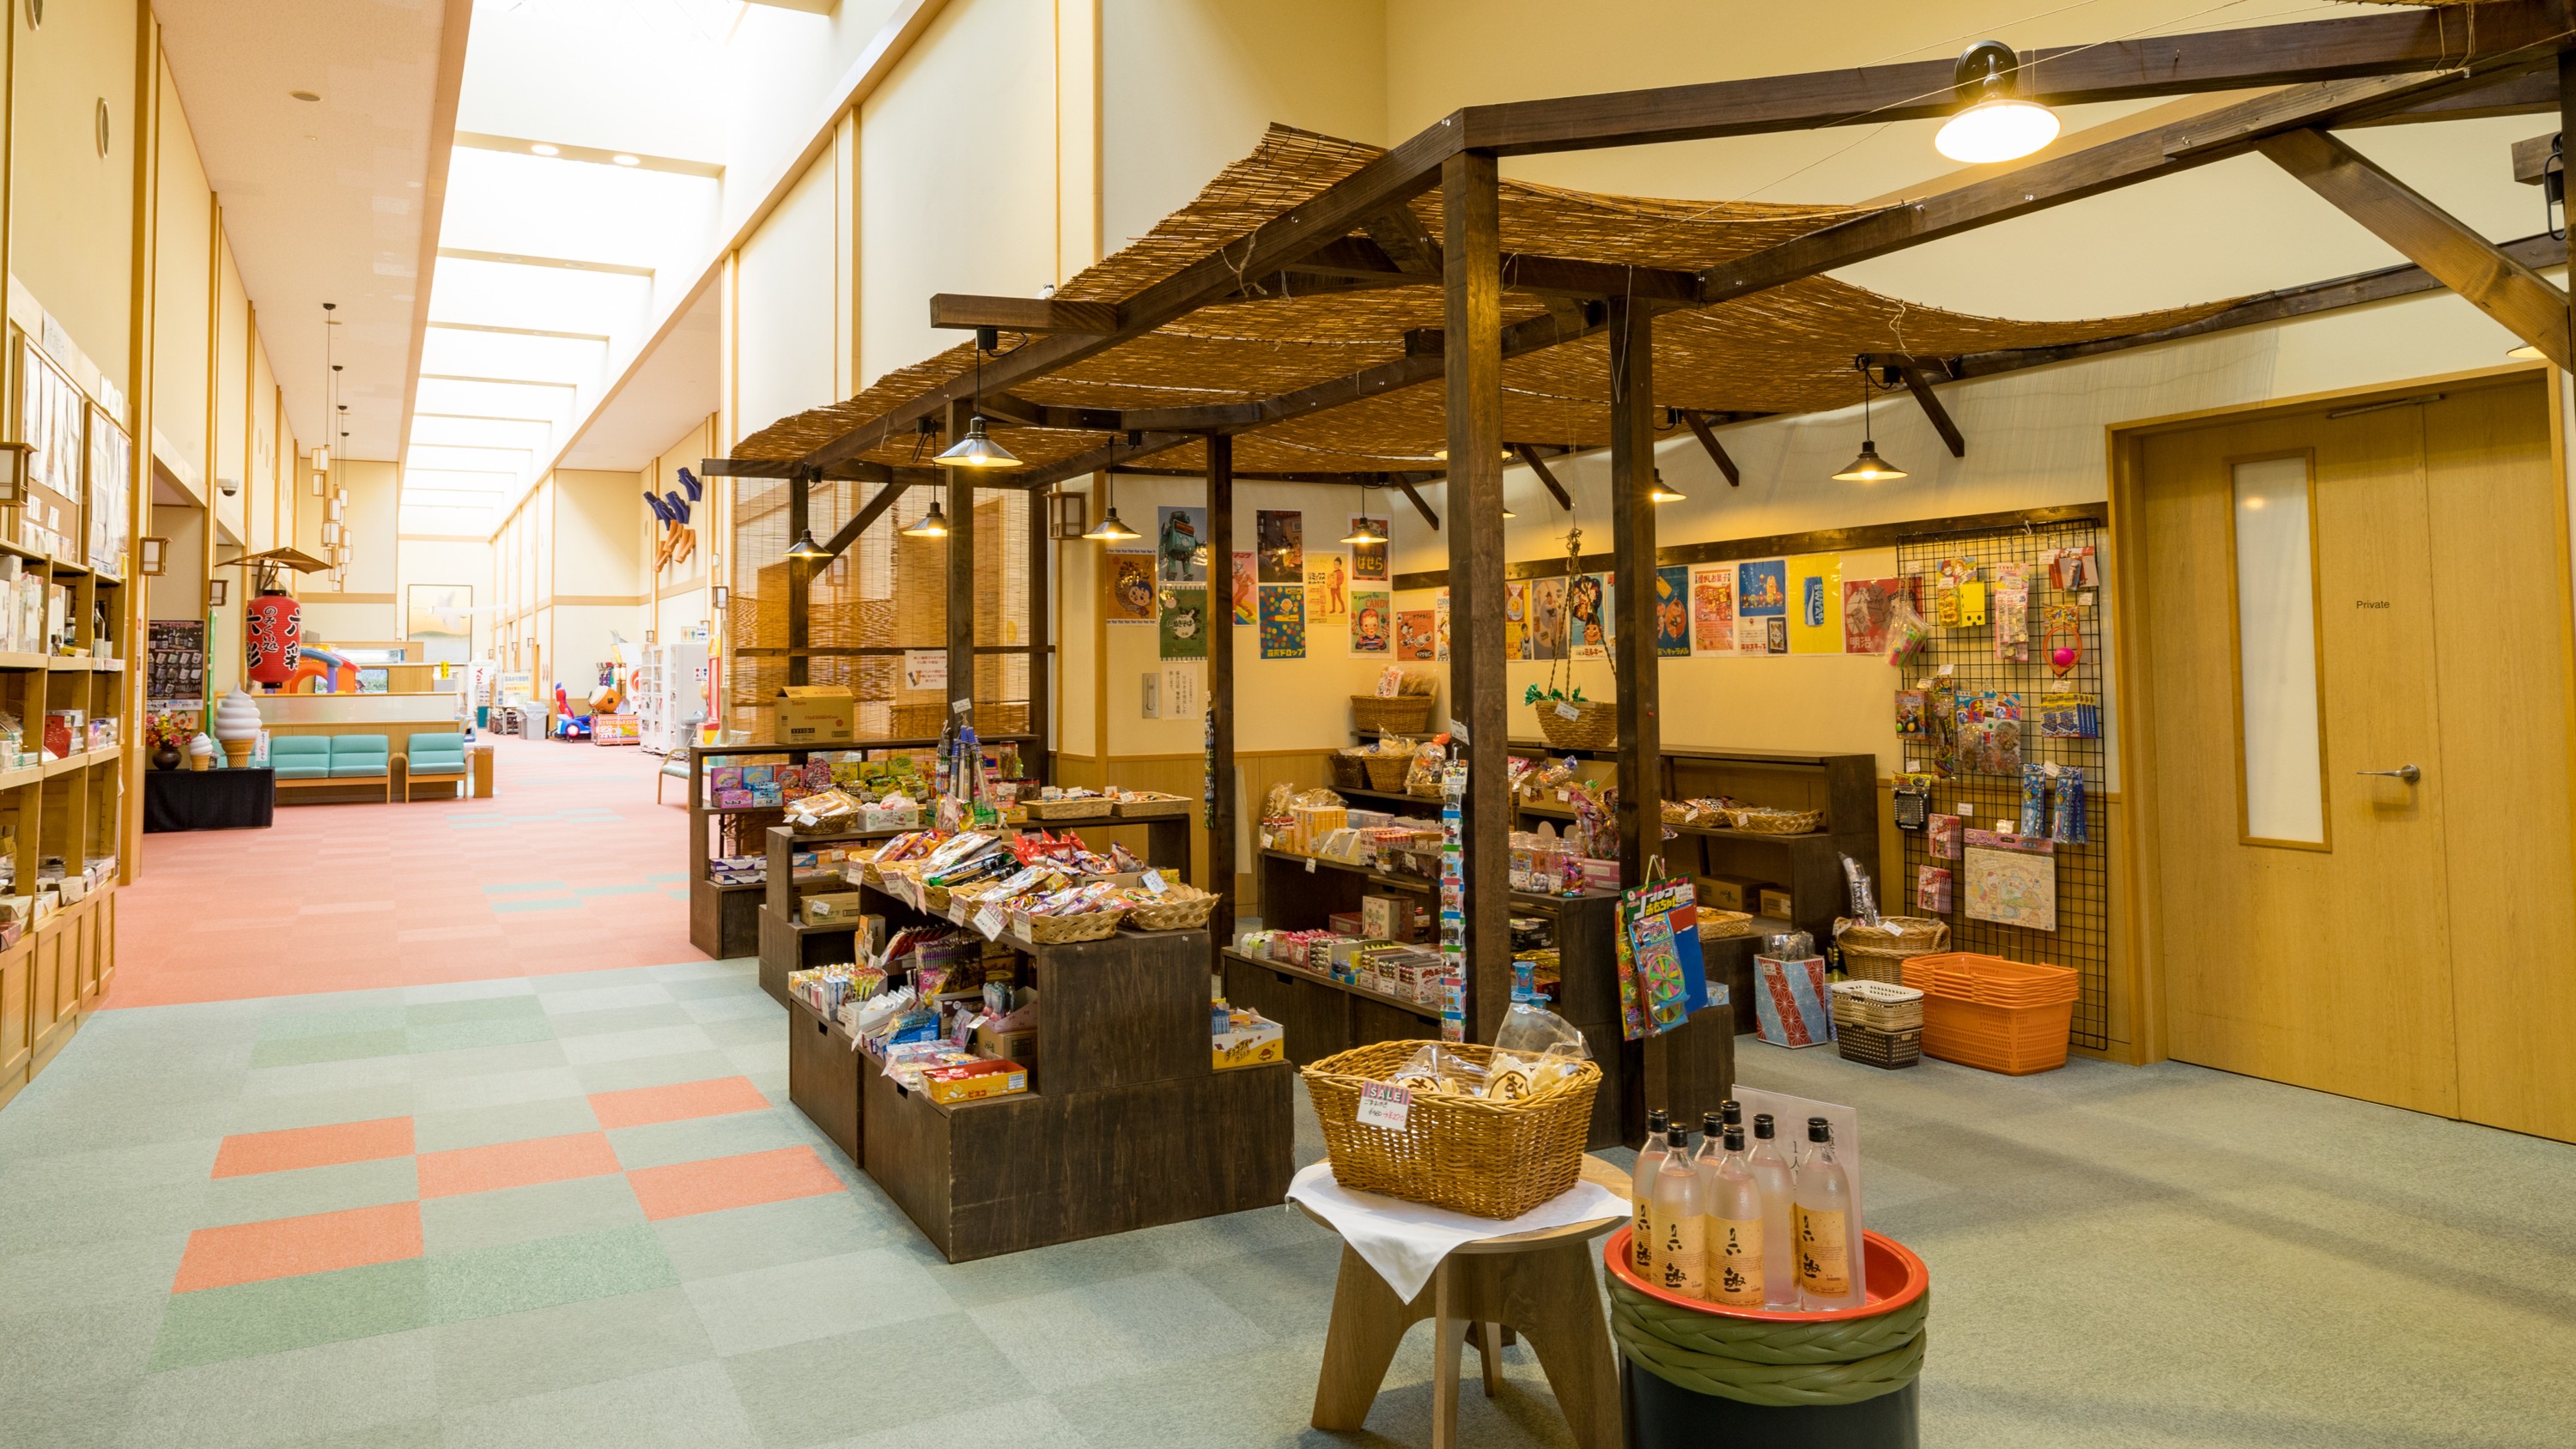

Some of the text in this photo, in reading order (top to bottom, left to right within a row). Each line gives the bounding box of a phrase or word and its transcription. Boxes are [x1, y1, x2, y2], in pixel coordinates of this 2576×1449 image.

[1364, 598, 1389, 609] CANDY
[2356, 600, 2391, 609] Private
[261, 605, 279, 653] のみくい処
[1850, 636, 1873, 649] 明治
[987, 905, 1004, 924] SALE
[968, 1089, 987, 1099] ビスコ
[1370, 1087, 1402, 1103] SALE
